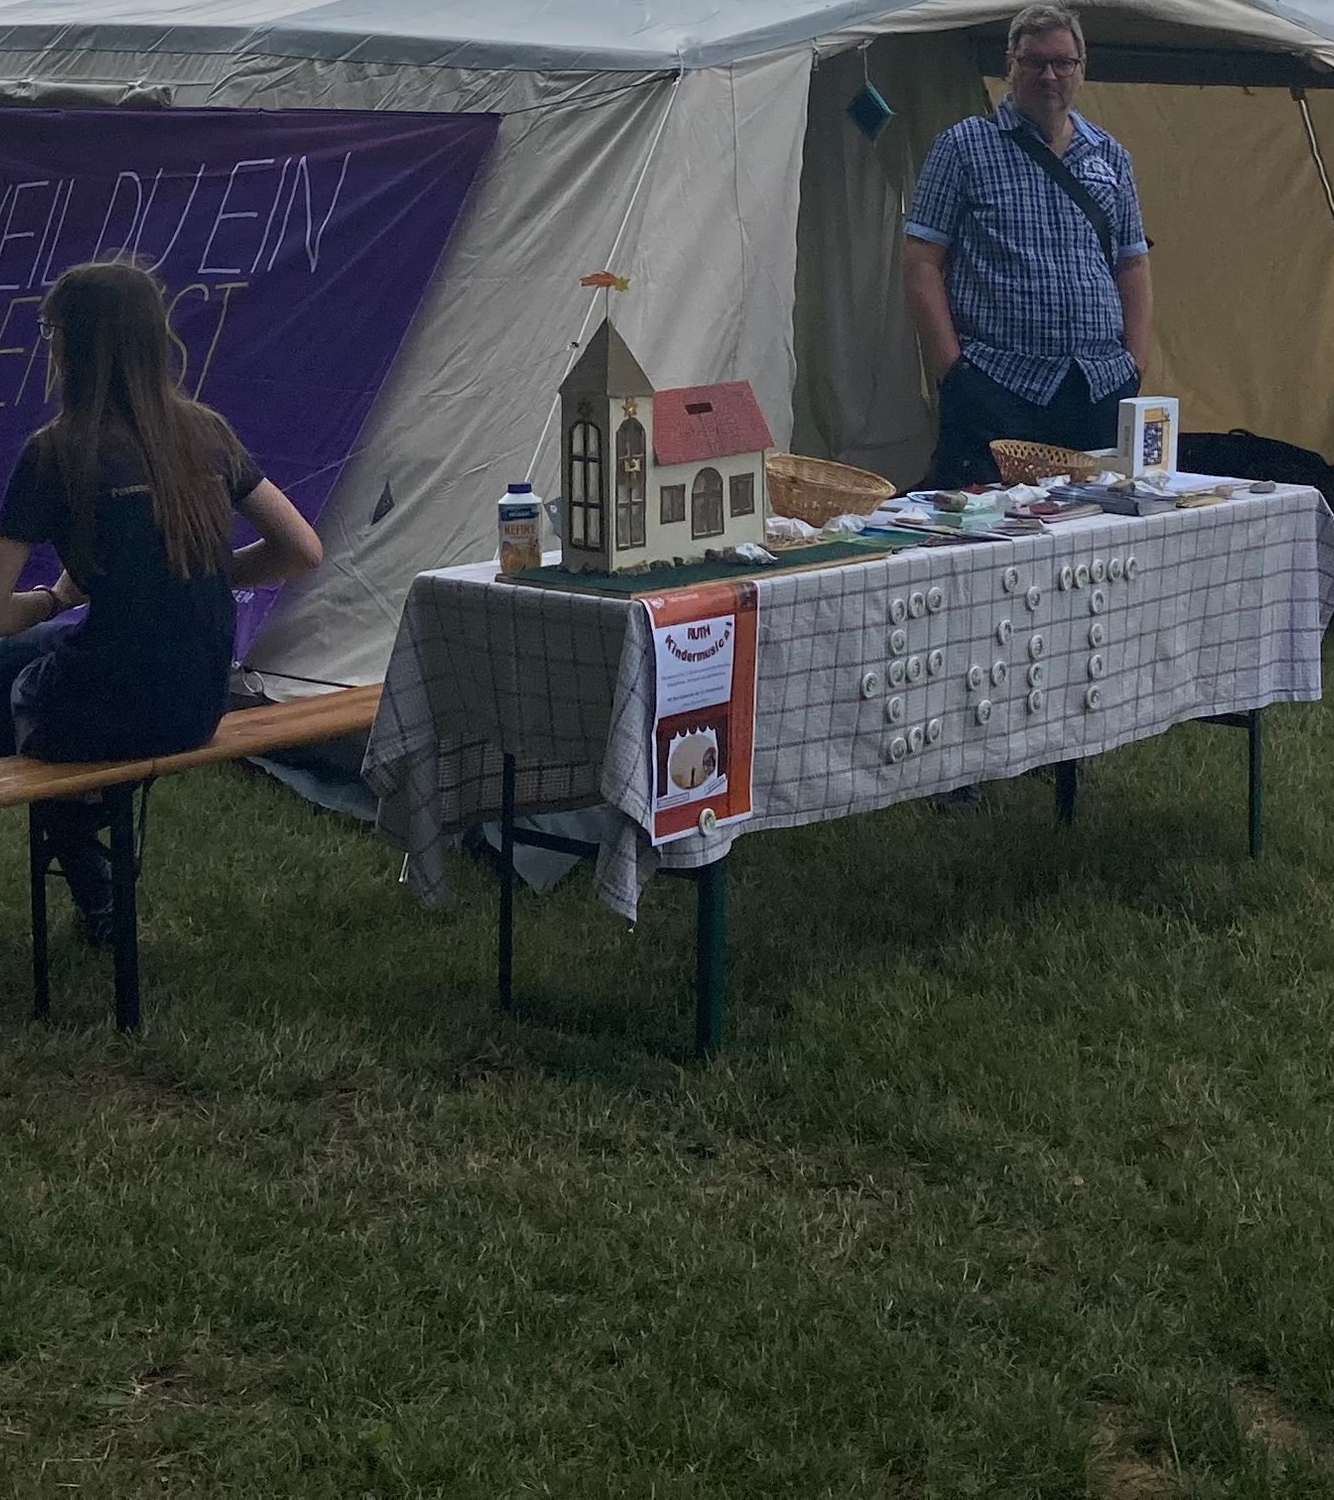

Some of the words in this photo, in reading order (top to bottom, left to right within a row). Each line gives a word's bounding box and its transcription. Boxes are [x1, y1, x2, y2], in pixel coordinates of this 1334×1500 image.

[91, 163, 206, 275] DU
[197, 151, 352, 274] EIN
[665, 621, 732, 662] Kindermusical
[687, 624, 711, 640] RUTH
